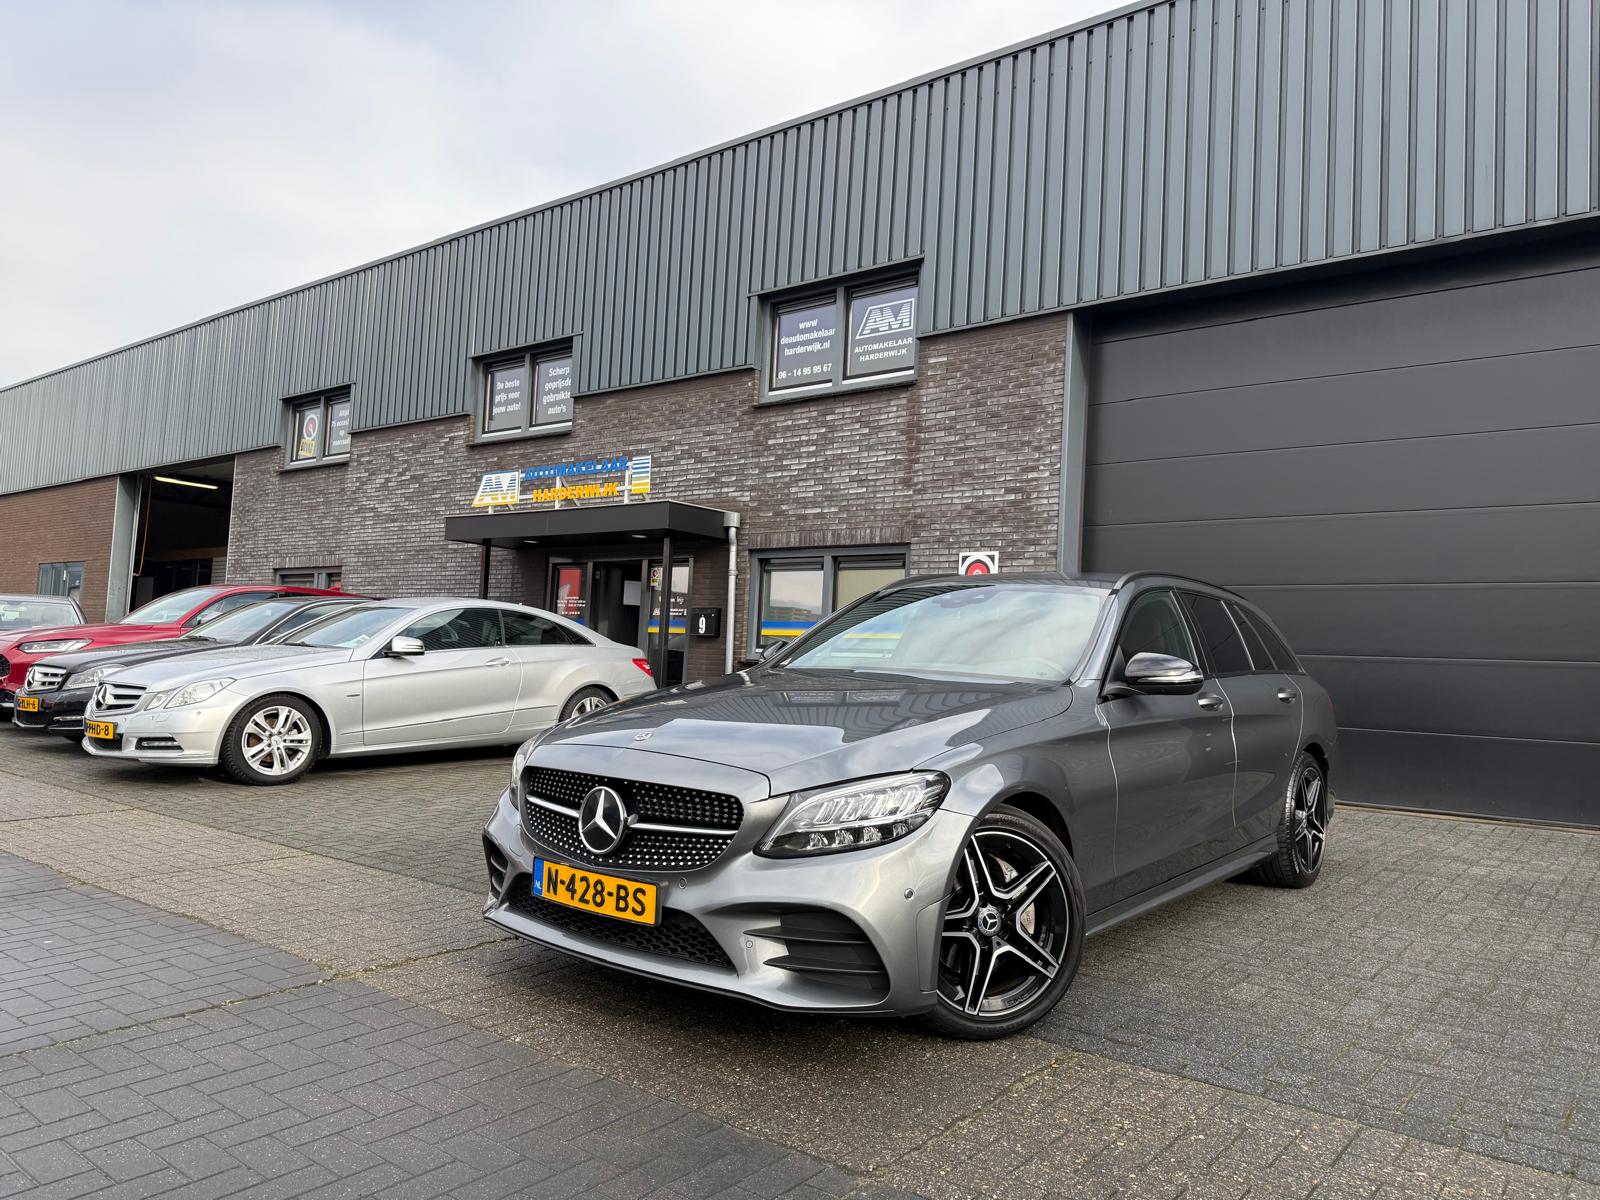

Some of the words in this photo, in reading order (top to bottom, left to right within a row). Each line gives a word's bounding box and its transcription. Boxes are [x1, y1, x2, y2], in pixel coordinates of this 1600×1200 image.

[780, 328, 836, 345] deautomakelaar
[784, 340, 831, 356] harderwijk.nl
[854, 337, 913, 354] AUTOMAKELAAR
[859, 348, 908, 362] HARDERWIJK
[549, 366, 570, 377] Scherp
[778, 371, 787, 379] 06
[793, 368, 802, 377] 14
[802, 366, 811, 375] 95
[813, 364, 822, 374] 95
[823, 363, 832, 372] 67
[497, 382, 504, 390] De
[505, 378, 520, 389] beste
[495, 392, 508, 405] prijs
[508, 391, 521, 399] voor
[507, 401, 521, 412] auto!
[547, 404, 567, 415] auto's
[524, 456, 630, 481] AUTOMAKELAAR
[532, 481, 619, 503] HARDERWIJK
[698, 616, 706, 634] 9
[546, 865, 647, 917] N-428-BS
